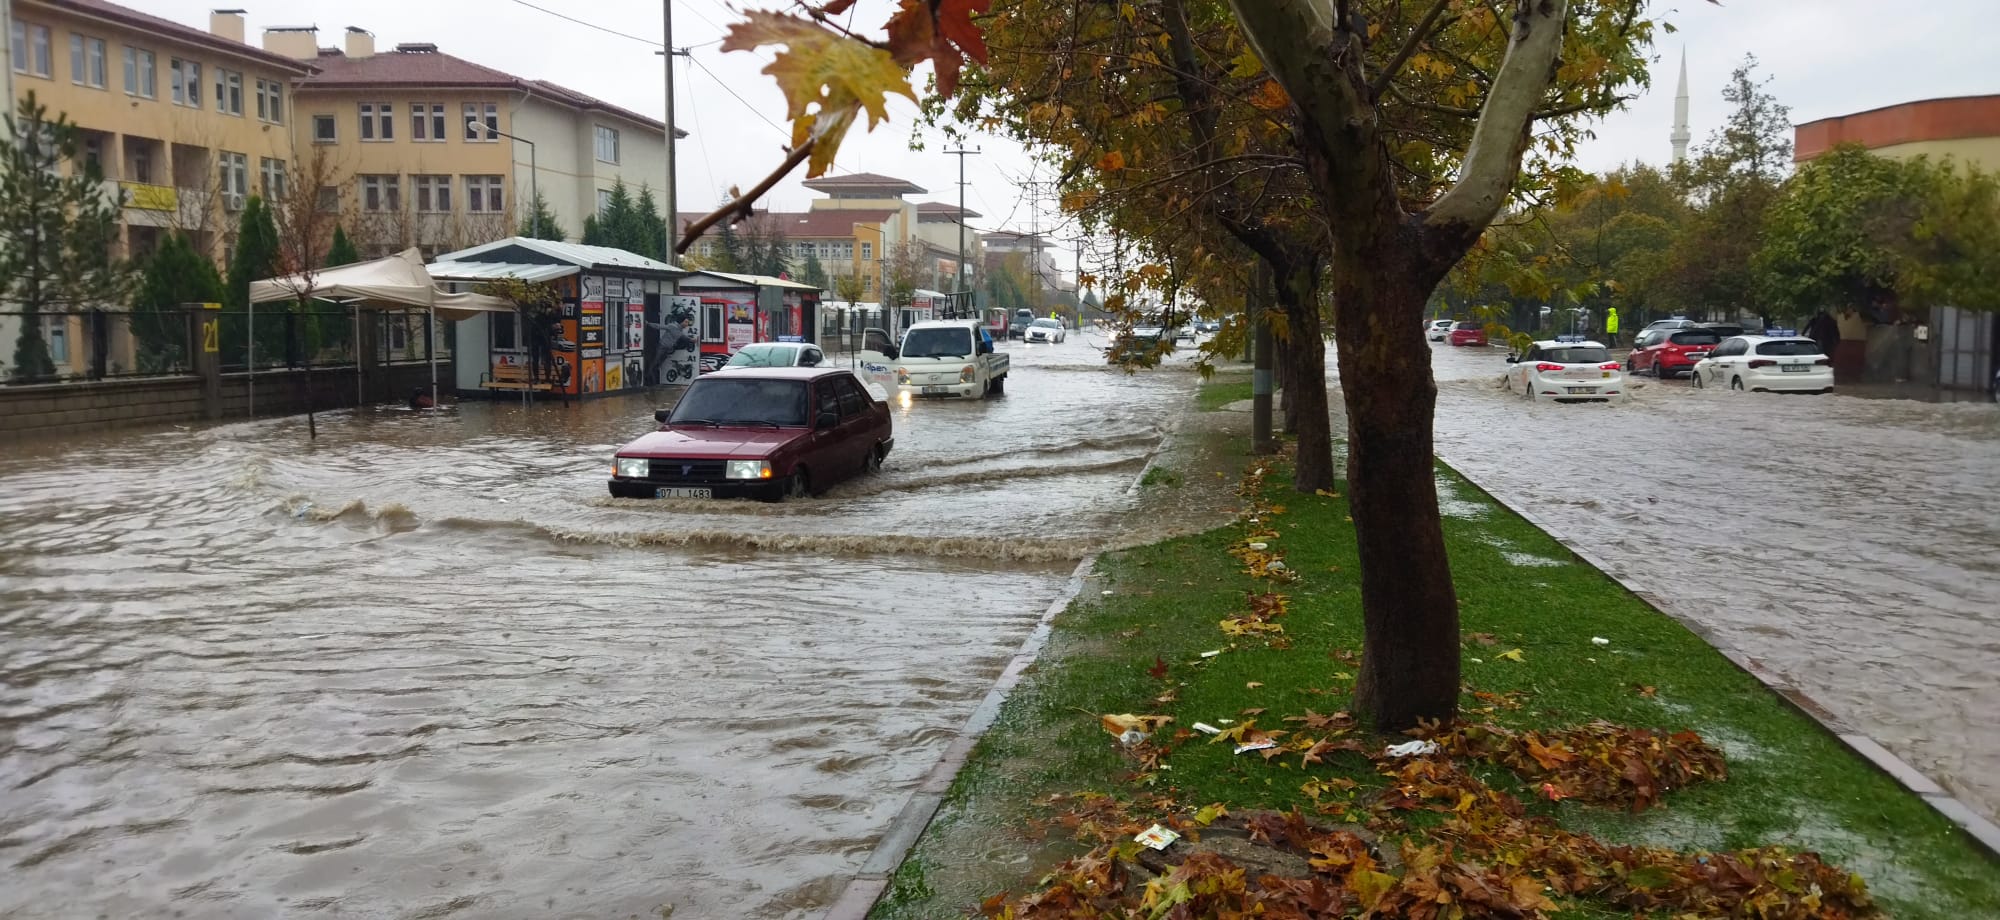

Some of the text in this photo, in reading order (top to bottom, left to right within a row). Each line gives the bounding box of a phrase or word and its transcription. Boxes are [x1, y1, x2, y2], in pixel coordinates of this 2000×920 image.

[203, 319, 219, 353] 21
[688, 327, 698, 335] A2
[687, 354, 696, 362] A1
[864, 362, 888, 374] Alpen
[660, 488, 672, 498] 07
[688, 489, 710, 499] 1483
